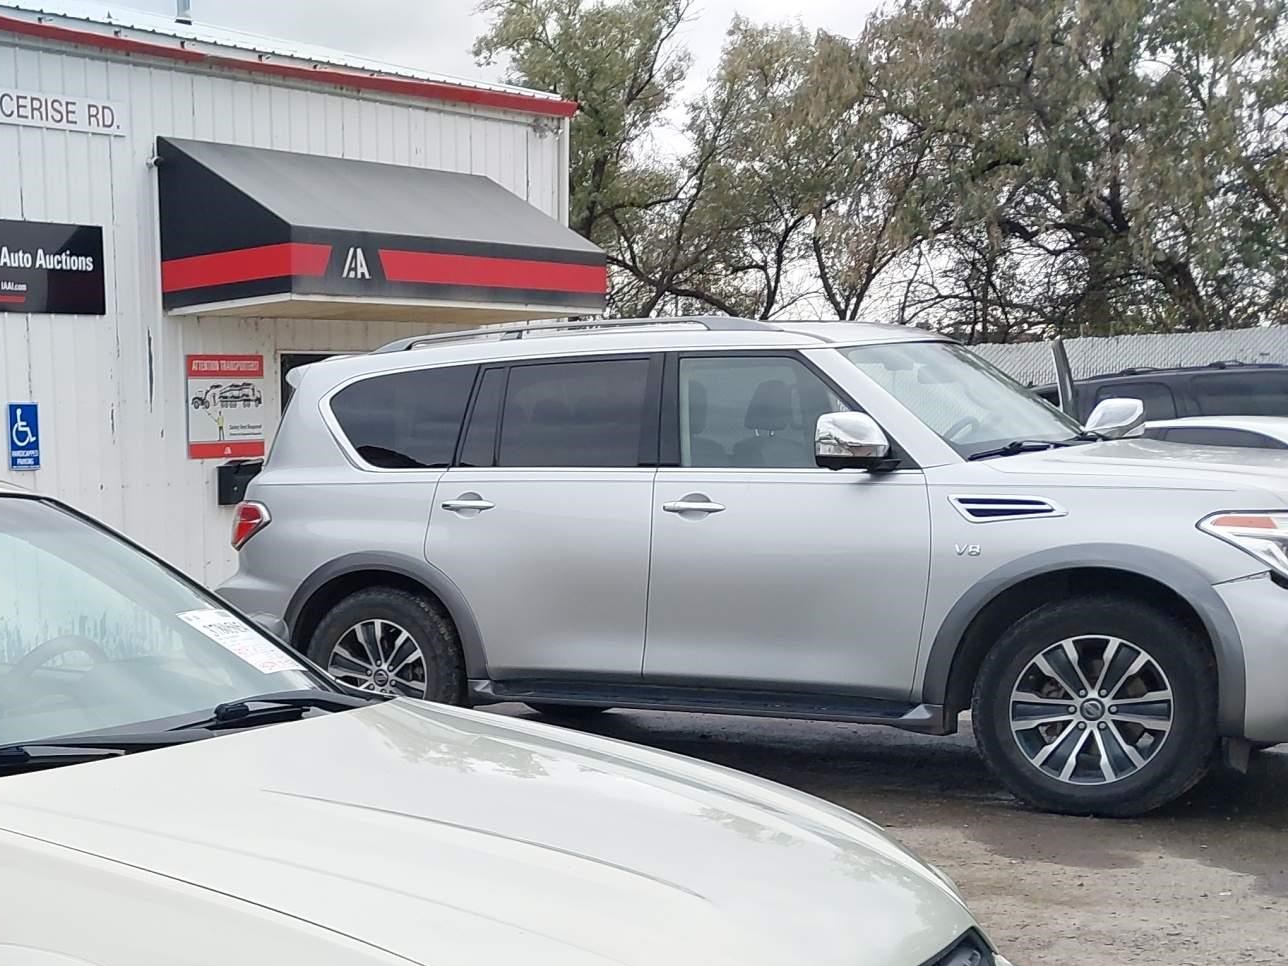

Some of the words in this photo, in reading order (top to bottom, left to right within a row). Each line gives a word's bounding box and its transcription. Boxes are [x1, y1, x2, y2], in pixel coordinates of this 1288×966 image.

[0, 93, 78, 125] CERISE
[87, 103, 121, 130] RD.
[0, 246, 32, 269] Auto
[35, 248, 94, 272] Auctions
[954, 543, 981, 557] V8
